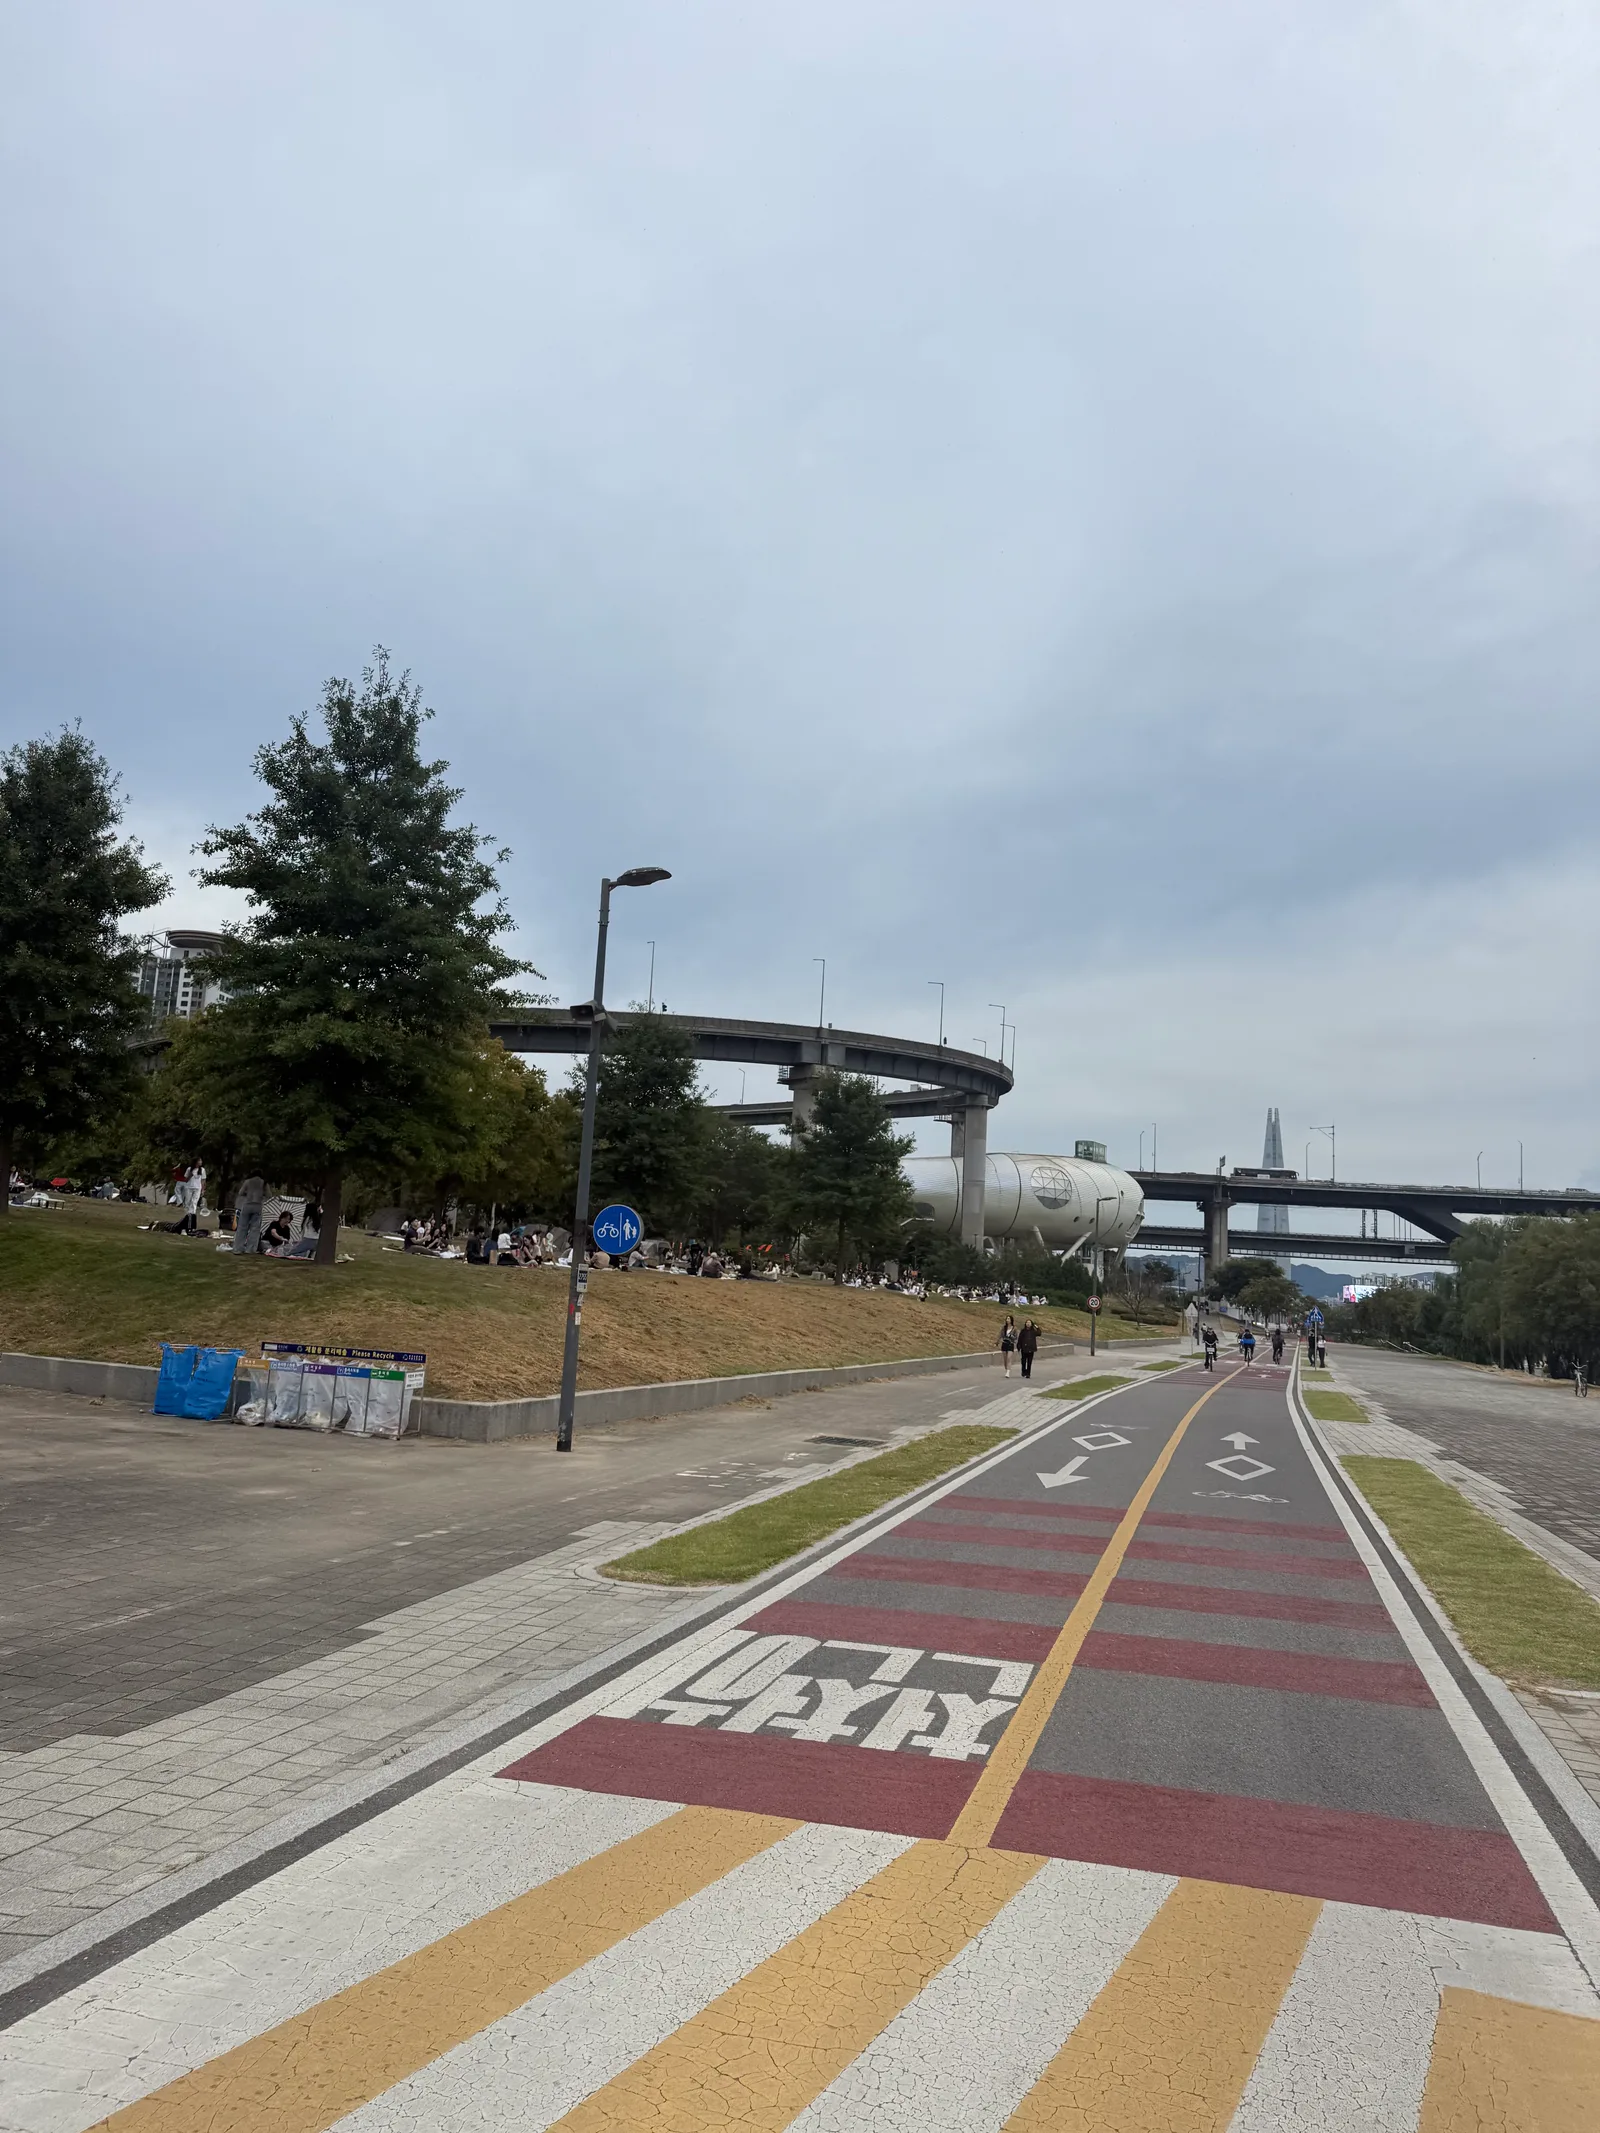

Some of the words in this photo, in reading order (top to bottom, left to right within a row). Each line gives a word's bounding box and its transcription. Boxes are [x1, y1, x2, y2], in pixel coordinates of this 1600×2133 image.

[352, 1350, 371, 1358] Please
[372, 1351, 395, 1360] Recycle
[594, 1630, 1035, 1760] 천천히
